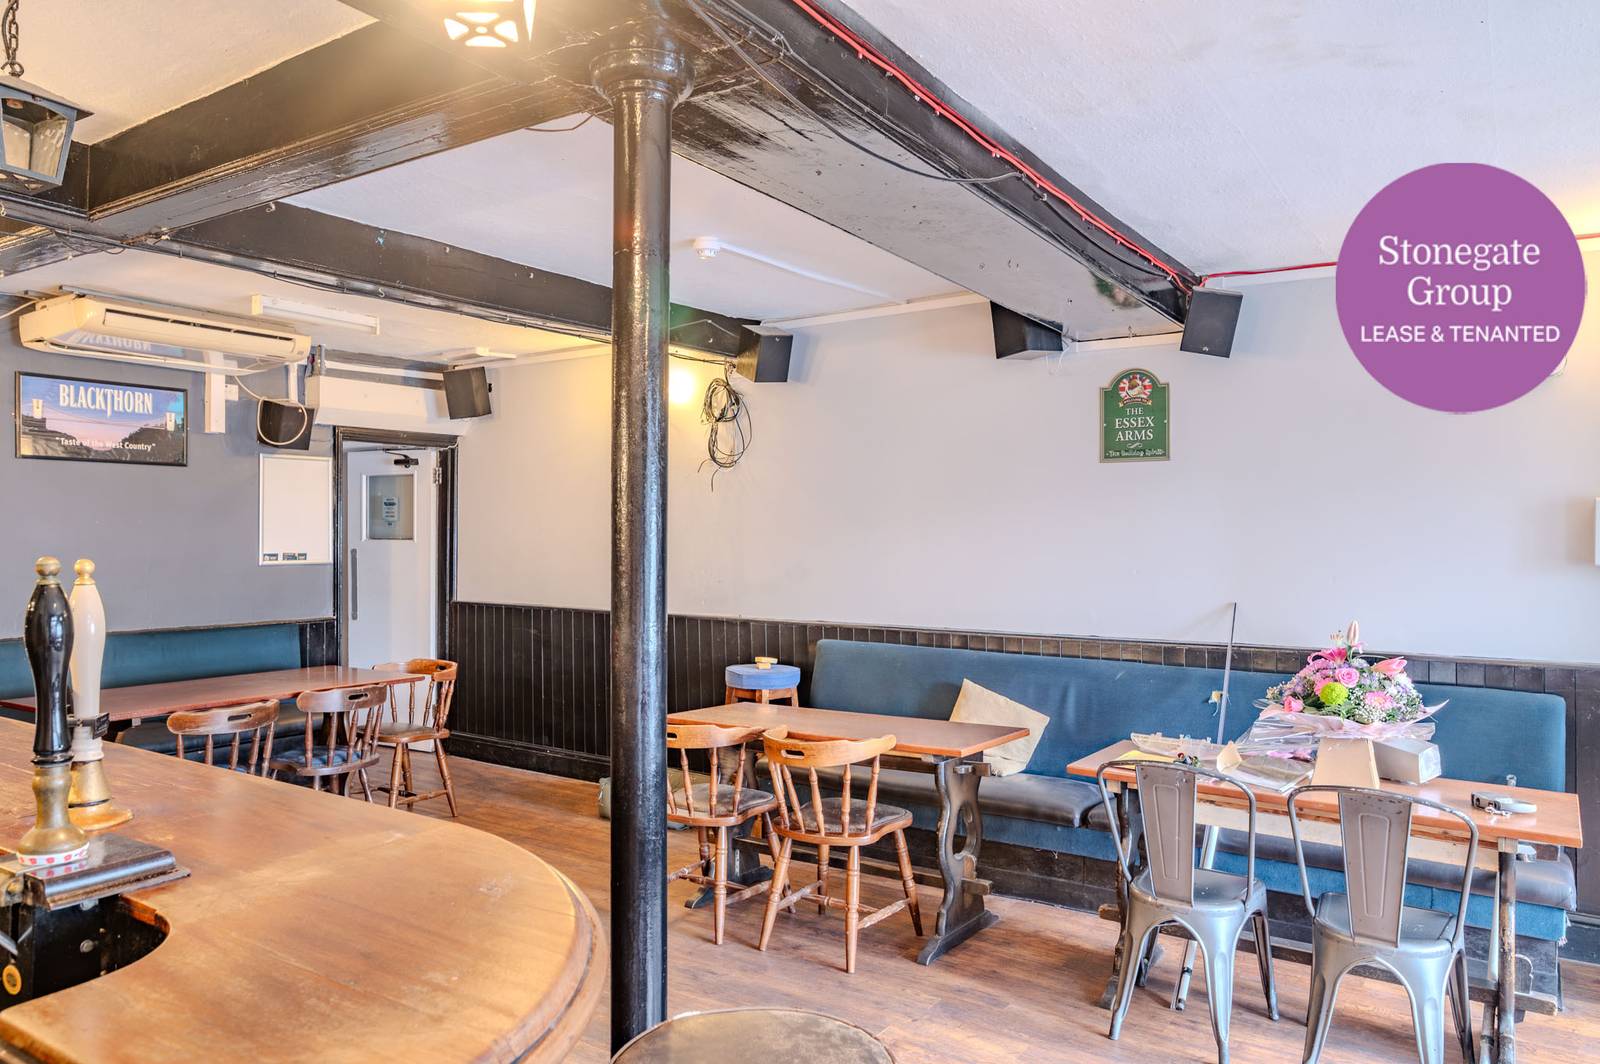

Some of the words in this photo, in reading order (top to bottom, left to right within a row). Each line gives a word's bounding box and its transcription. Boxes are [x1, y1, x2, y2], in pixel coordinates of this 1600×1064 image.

[59, 383, 153, 417] BLACKTHORN
[1125, 407, 1144, 416] THE
[1115, 416, 1155, 429] ESSEX
[1115, 428, 1154, 441] ARMS
[106, 441, 123, 449] West
